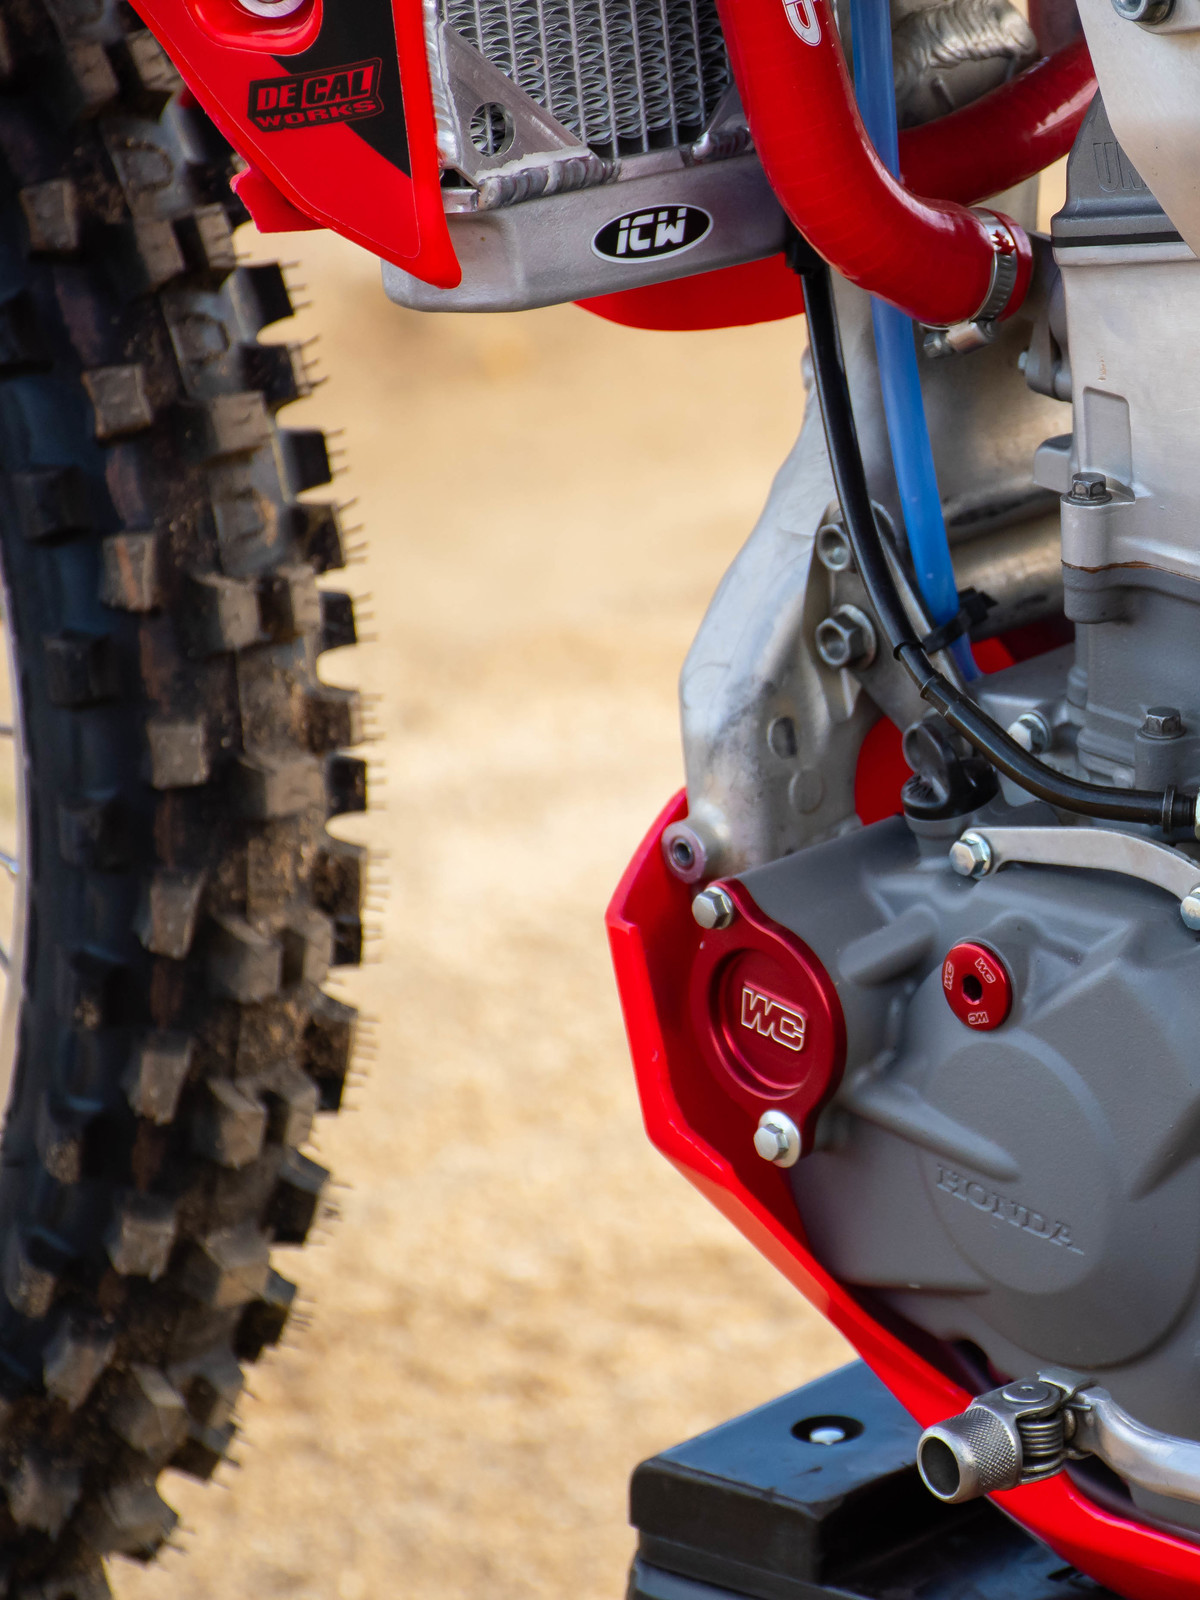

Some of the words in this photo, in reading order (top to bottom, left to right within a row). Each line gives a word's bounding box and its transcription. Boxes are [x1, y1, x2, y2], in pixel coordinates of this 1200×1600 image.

[255, 99, 377, 128] WORKS
[974, 956, 997, 985] WC
[740, 986, 806, 1052] WC
[935, 1163, 1085, 1256] HONDA
